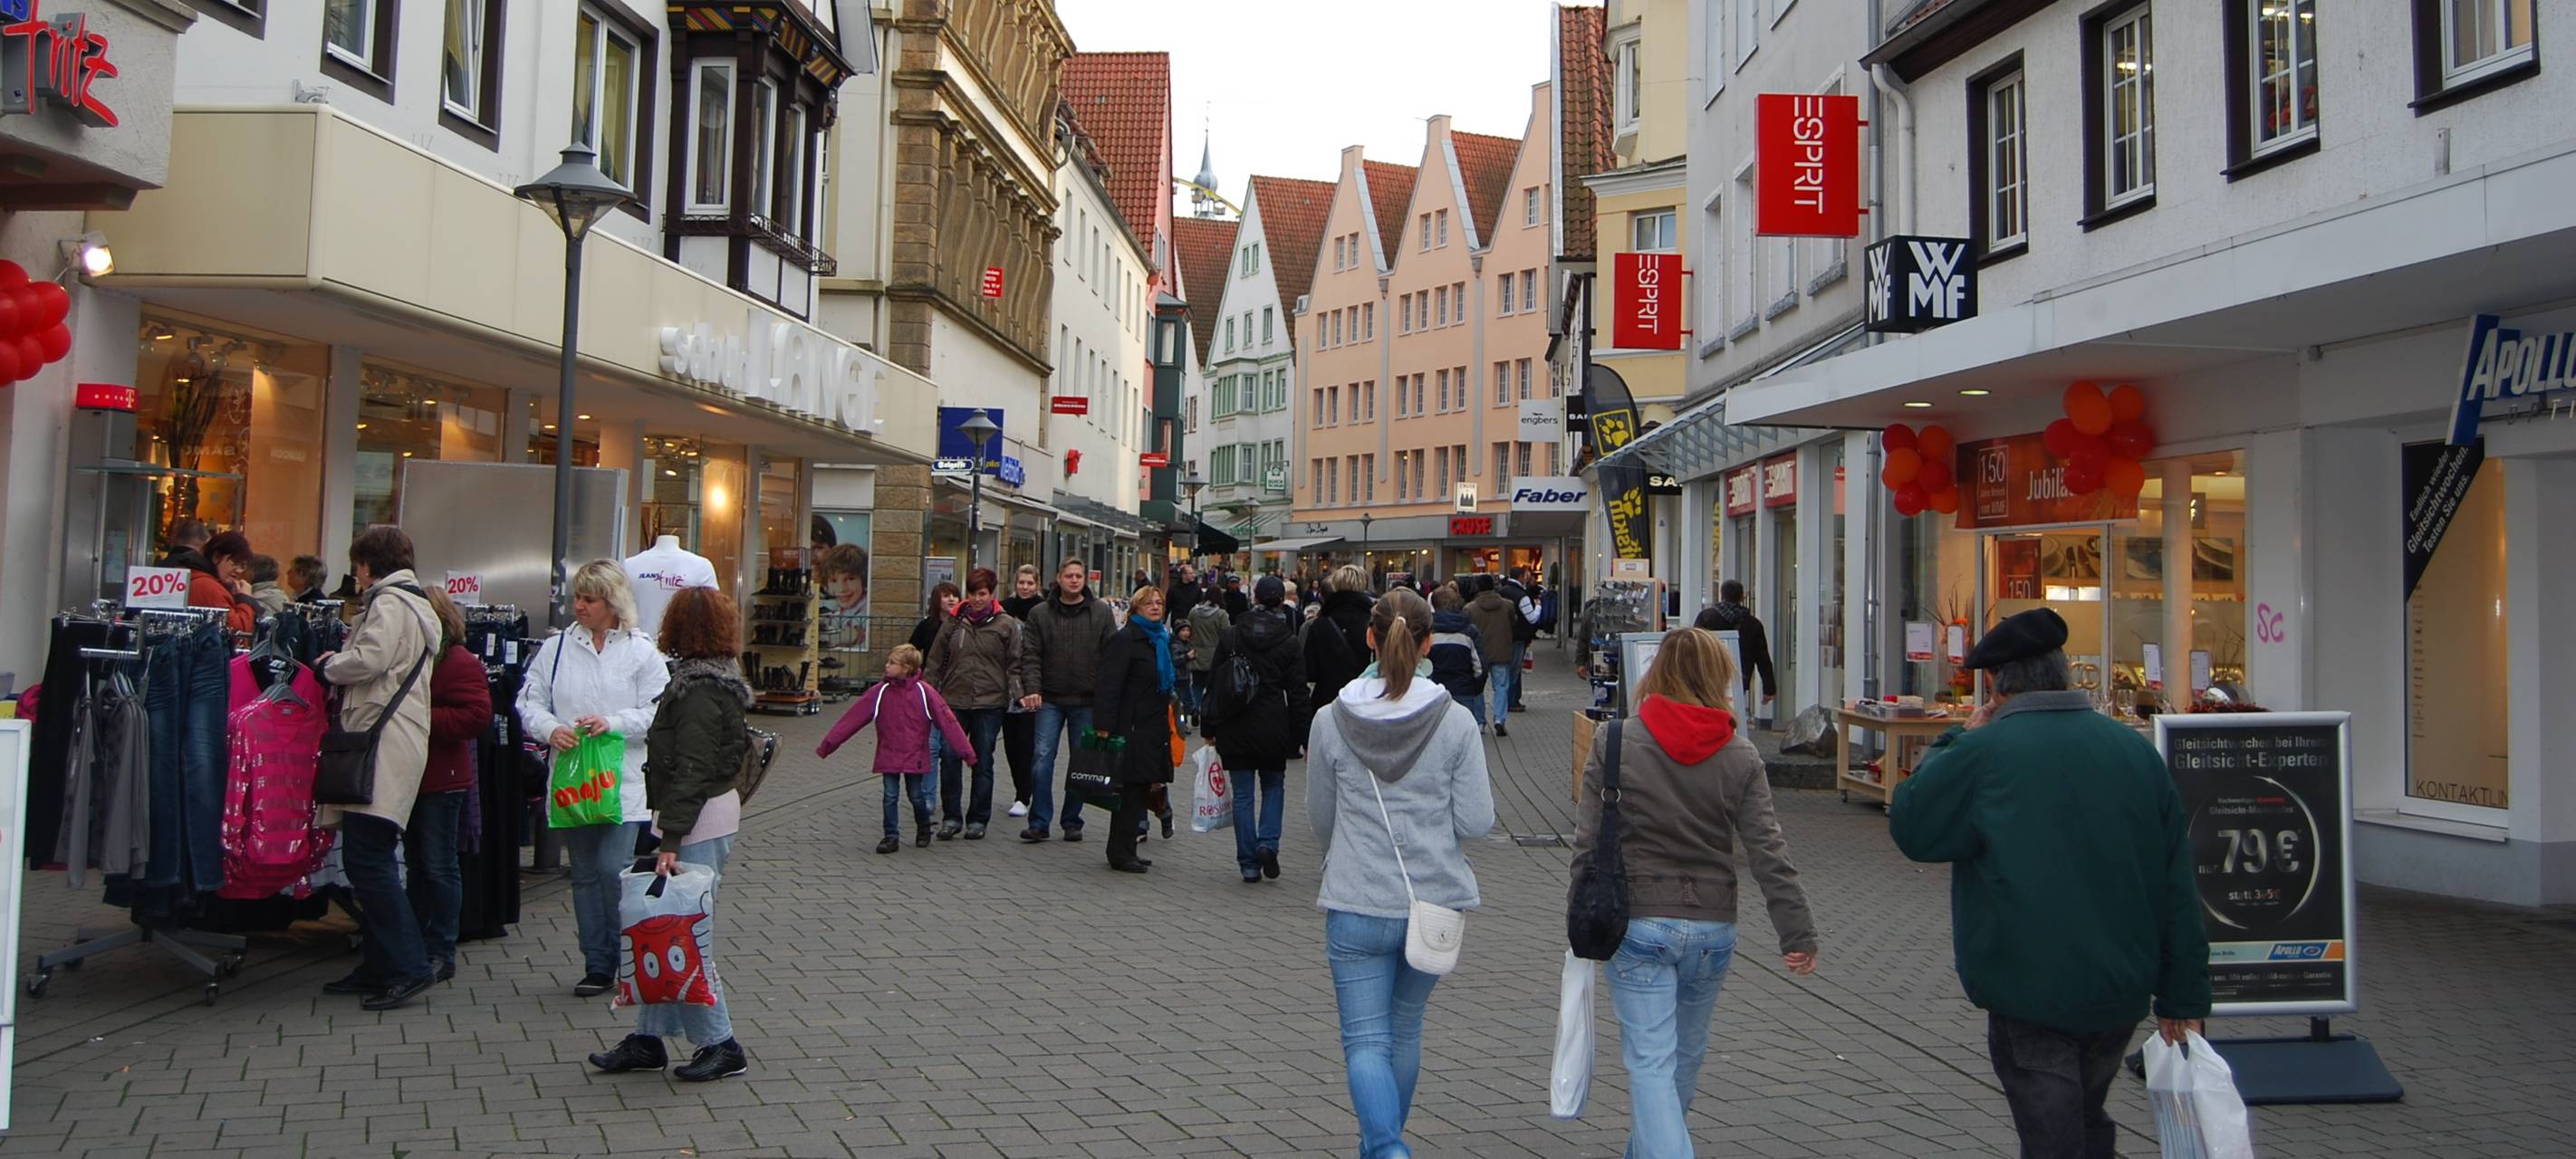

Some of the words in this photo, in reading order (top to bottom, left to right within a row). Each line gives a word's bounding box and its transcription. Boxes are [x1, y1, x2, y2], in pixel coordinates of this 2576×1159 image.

[4, 0, 120, 127] fritz
[1793, 96, 1824, 215] ESPRIT
[1908, 240, 1966, 320] WMF
[1638, 254, 1659, 335] ESPRIT
[745, 306, 885, 436] LANGE
[1521, 416, 1559, 426] engbers
[1980, 452, 2006, 484] 150
[1648, 475, 1684, 487] SA
[1513, 488, 1588, 503] Faber
[2442, 496, 2456, 517] Sie
[1451, 517, 1493, 536] CRUSE
[131, 571, 187, 597] 20%
[447, 576, 479, 594] 20%
[2275, 735, 2293, 749] bei
[2217, 829, 2267, 874] 79
[2273, 944, 2302, 956] APOLLO
